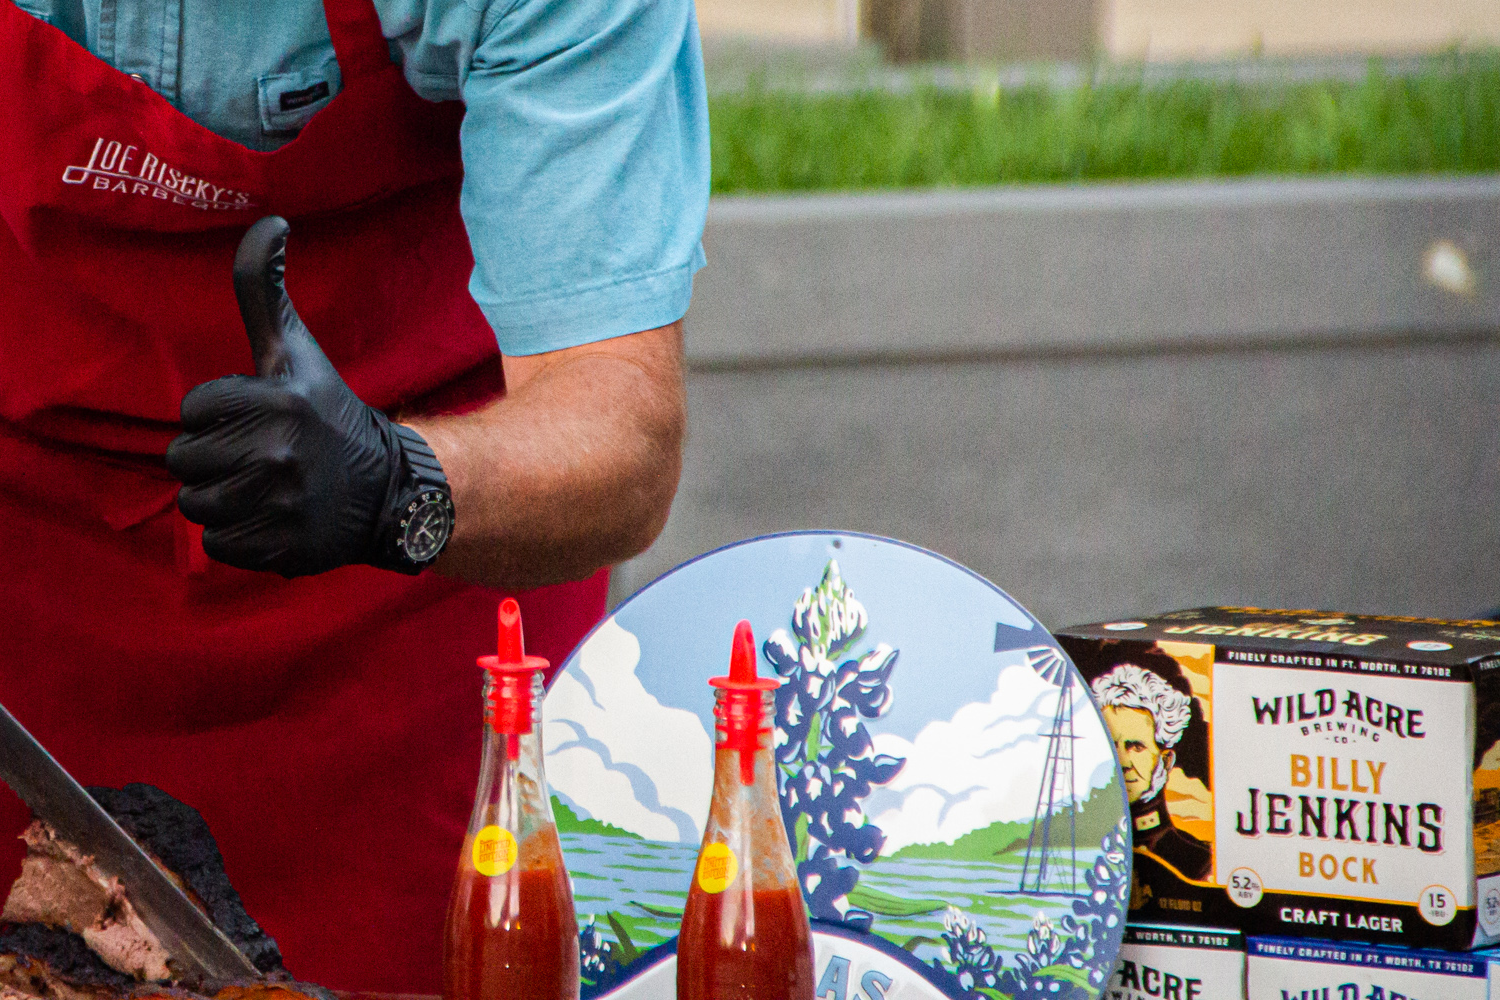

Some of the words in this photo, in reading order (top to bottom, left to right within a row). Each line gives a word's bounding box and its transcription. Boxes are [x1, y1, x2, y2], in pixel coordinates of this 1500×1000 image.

[62, 137, 138, 185] JOE
[1227, 651, 1267, 663] FINELY
[1270, 654, 1322, 667] CRAFTED
[1326, 658, 1338, 668] IN
[1342, 659, 1357, 670] FT.
[1360, 661, 1401, 674] WORTH,
[1404, 664, 1418, 675] TX
[1421, 666, 1451, 677] 76102
[1251, 688, 1337, 725] WILD
[1342, 689, 1427, 739] ACRE
[1300, 721, 1380, 743] BREWING
[1290, 754, 1387, 795] BILLY
[1236, 788, 1445, 855] JENKINS
[1299, 851, 1379, 885] BOCK
[1428, 893, 1447, 909] 15
[1280, 907, 1340, 926] CRAFT
[1345, 913, 1404, 933] LAGER
[1136, 931, 1178, 943] WORTH,
[1181, 935, 1195, 945] TX
[1198, 936, 1230, 947] 76102
[1257, 943, 1295, 956] FINELY
[1299, 948, 1347, 960] CRAFTED
[1350, 953, 1363, 962] IN
[1366, 954, 1382, 964] FT.
[1385, 956, 1425, 969] WORTH,
[1428, 960, 1442, 970] TX
[1444, 962, 1474, 973] 76102
[816, 954, 893, 1000] AS
[1116, 959, 1202, 1000] ACRE
